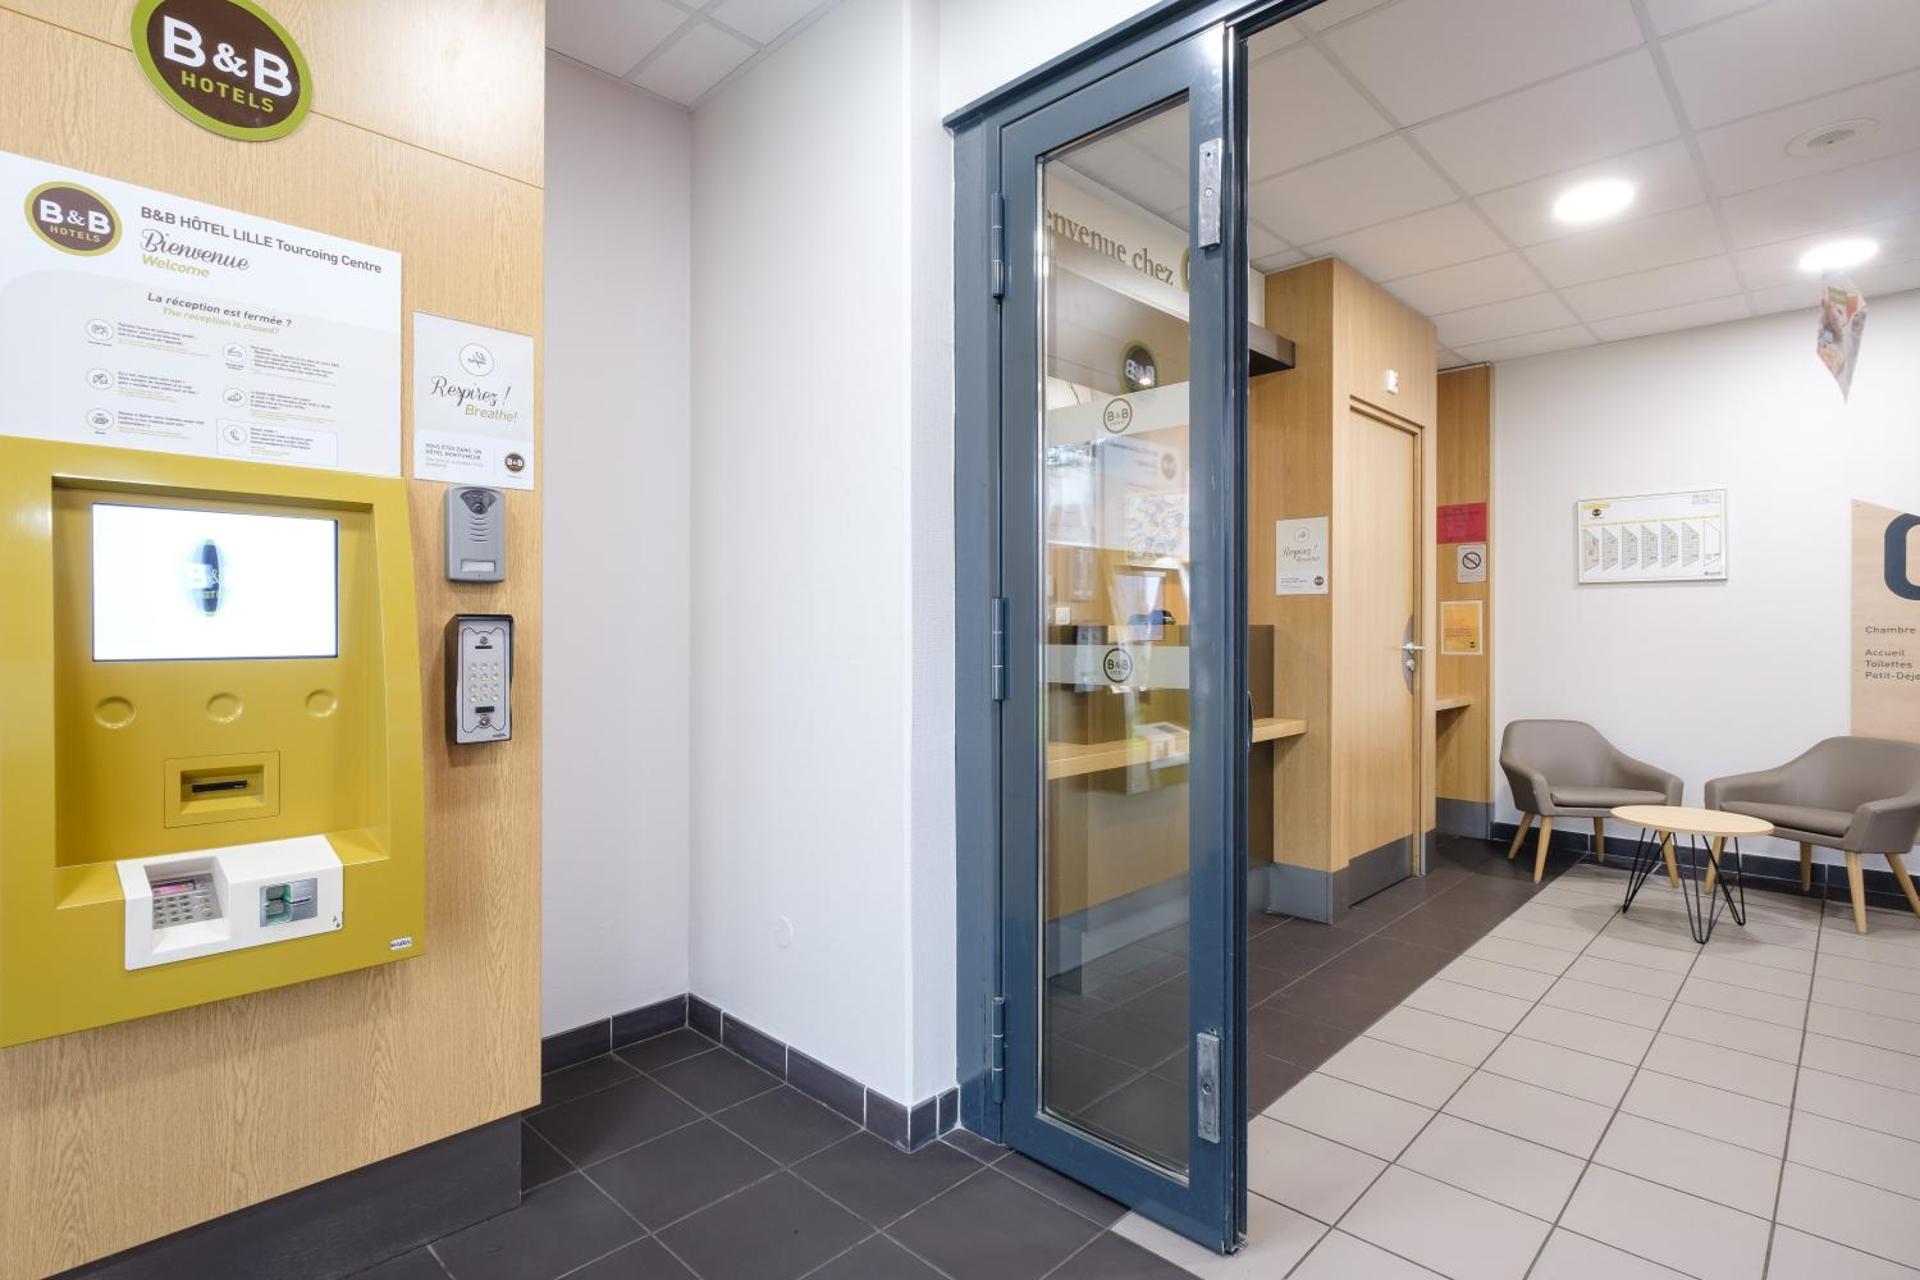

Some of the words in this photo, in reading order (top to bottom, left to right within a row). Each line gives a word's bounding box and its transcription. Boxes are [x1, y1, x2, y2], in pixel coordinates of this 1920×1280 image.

[163, 15, 293, 97] B&B
[180, 70, 275, 113] HOTELS
[39, 199, 111, 235] B&B
[50, 225, 101, 243] HOTELS
[140, 206, 176, 225] B&B
[180, 215, 230, 238] HÔTEL
[233, 228, 273, 248] LILLE
[276, 238, 338, 266] Tourcoing
[341, 255, 382, 274] Centre
[140, 228, 250, 271] Bienvenue
[142, 255, 210, 278] Welcome
[147, 292, 163, 304] La
[165, 295, 220, 315] réception
[223, 307, 242, 319] est
[243, 310, 283, 327] fermée
[431, 376, 498, 407] Respirez
[465, 404, 519, 423] Breathe!
[1865, 626, 1916, 634] Chambre
[1865, 648, 1905, 657] Accueil
[1865, 659, 1913, 669] Toilettes
